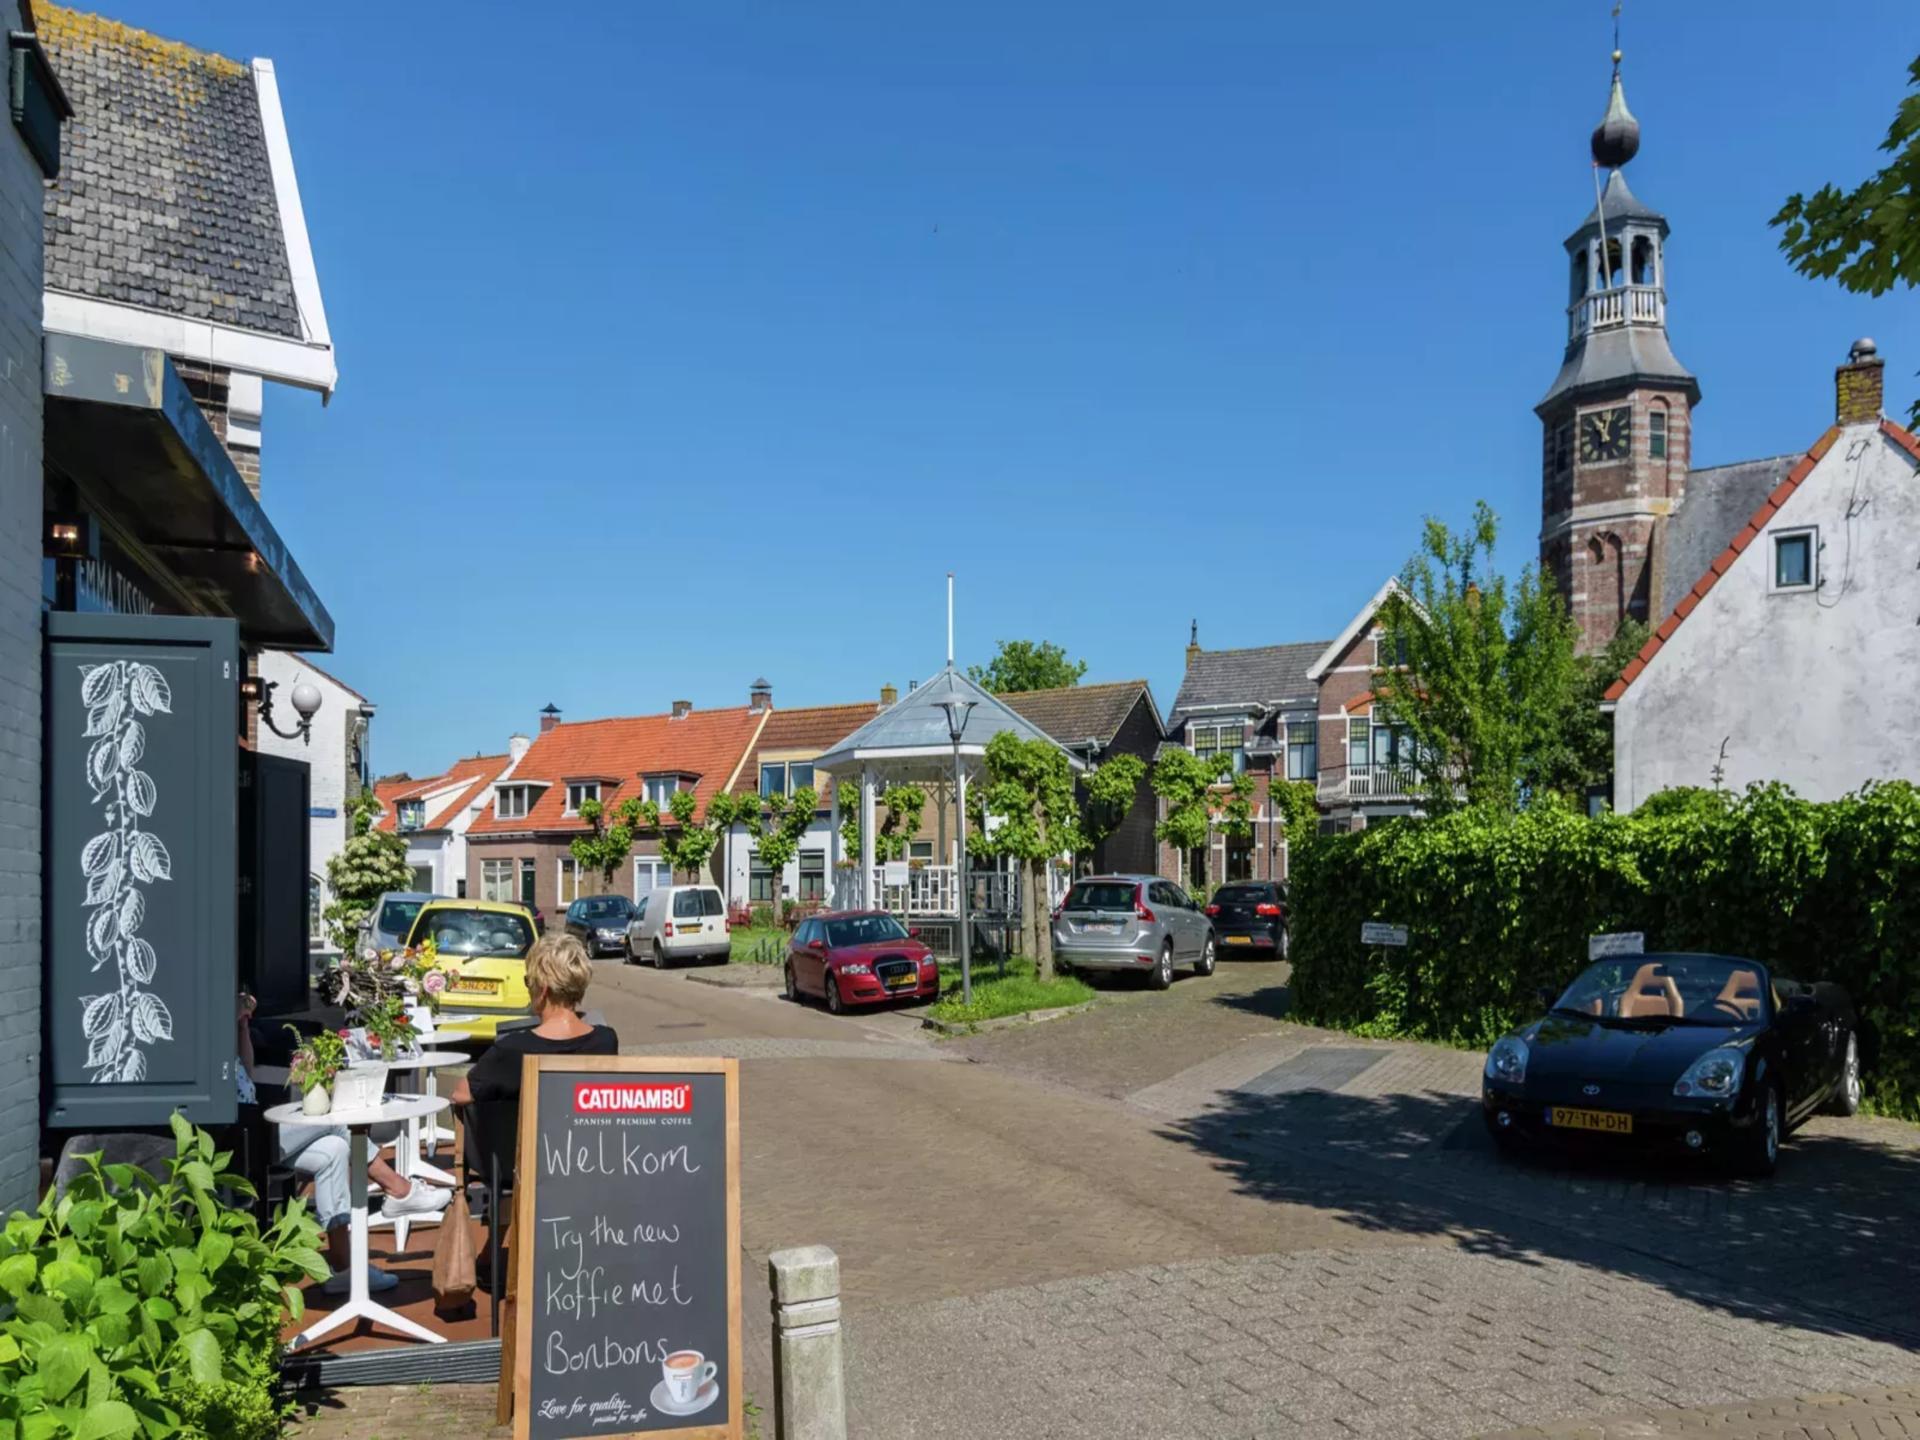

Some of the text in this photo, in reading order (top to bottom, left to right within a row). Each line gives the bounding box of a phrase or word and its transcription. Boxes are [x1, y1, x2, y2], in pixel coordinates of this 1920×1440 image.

[573, 1117, 693, 1126] SPANISH PREMIUM COFFEE
[541, 1215, 681, 1281] Try the new
[631, 1264, 694, 1306] met
[543, 1329, 669, 1376] Bonbons
[538, 1397, 567, 1420] Love
[565, 1395, 588, 1419] for
